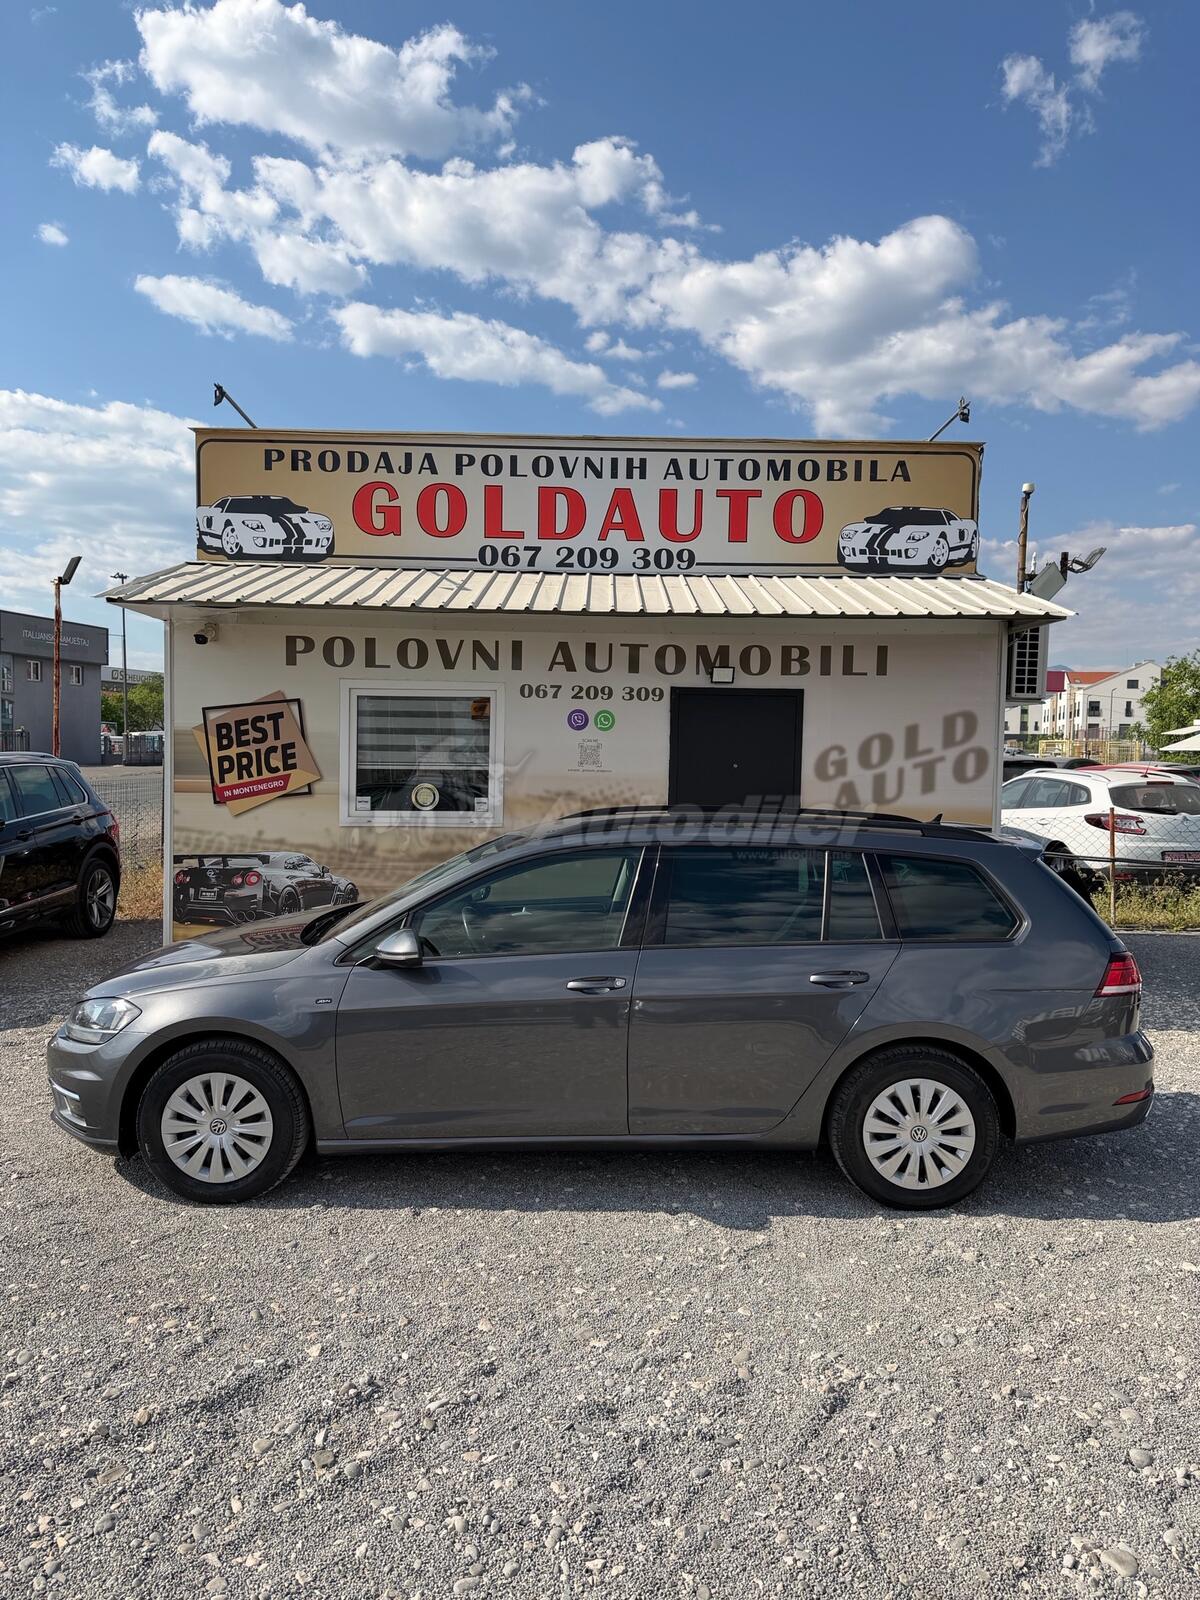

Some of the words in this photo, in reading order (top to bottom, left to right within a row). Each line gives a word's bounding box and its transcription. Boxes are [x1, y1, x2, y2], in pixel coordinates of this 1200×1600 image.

[264, 448, 439, 475] PRODAJA
[455, 453, 648, 480] POLOVNIH
[663, 457, 912, 483] AUTOMOBILA
[352, 480, 825, 545] GOLDAUTO
[477, 544, 542, 569] 067
[555, 545, 619, 570] 209
[632, 547, 697, 571] 309
[285, 635, 523, 671] POLOVNI
[548, 641, 889, 677] AUTOMOBILI
[519, 683, 562, 699] 067
[571, 685, 614, 701] 209
[622, 686, 665, 702] 309
[215, 711, 285, 752] BEST
[813, 709, 979, 783] GOLD
[217, 742, 298, 784] PRICE
[834, 745, 990, 810] AUTO
[223, 789, 232, 797] IN
[233, 779, 285, 796] MONTENEGRO
